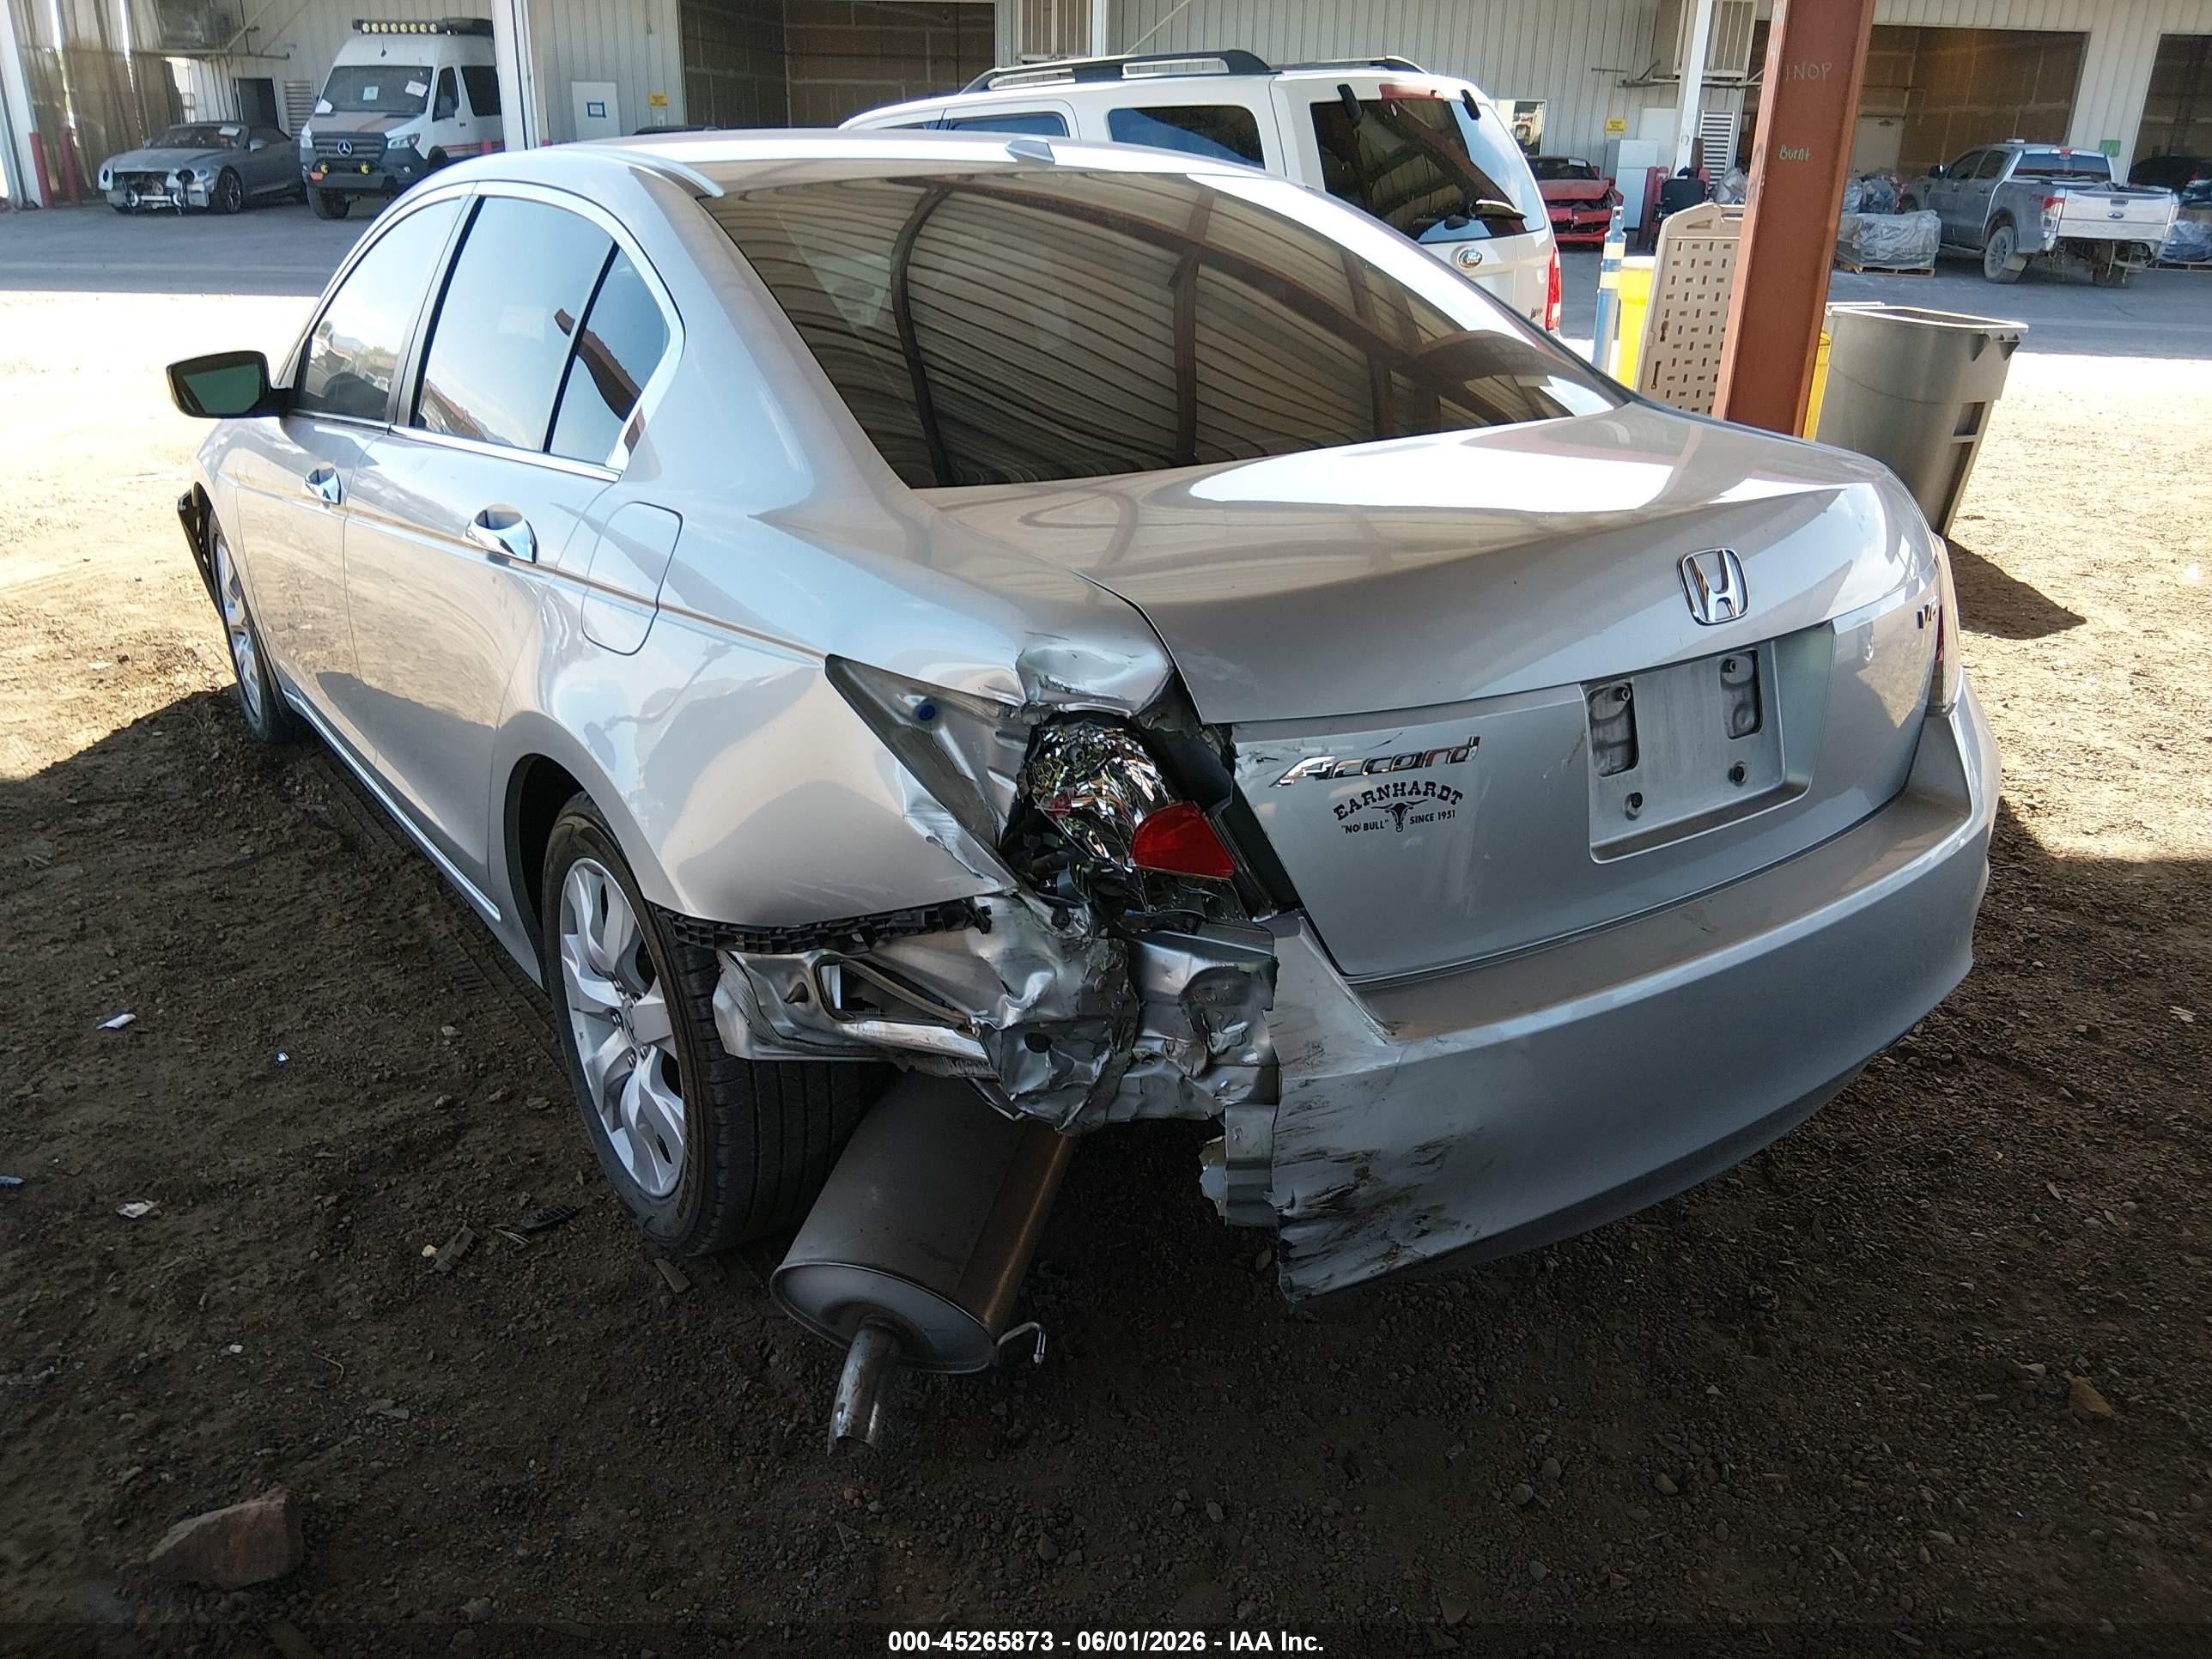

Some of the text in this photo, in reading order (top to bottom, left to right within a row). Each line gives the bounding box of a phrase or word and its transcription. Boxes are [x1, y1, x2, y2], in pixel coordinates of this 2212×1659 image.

[1785, 61, 1832, 82] INOP
[1778, 143, 1811, 161] Burnt
[1268, 735, 1481, 788] Accord
[1333, 781, 1463, 821] EARNHARDT
[1363, 818, 1389, 831] BULL"
[1409, 811, 1434, 824] SINCE
[1437, 810, 1456, 821] 1951
